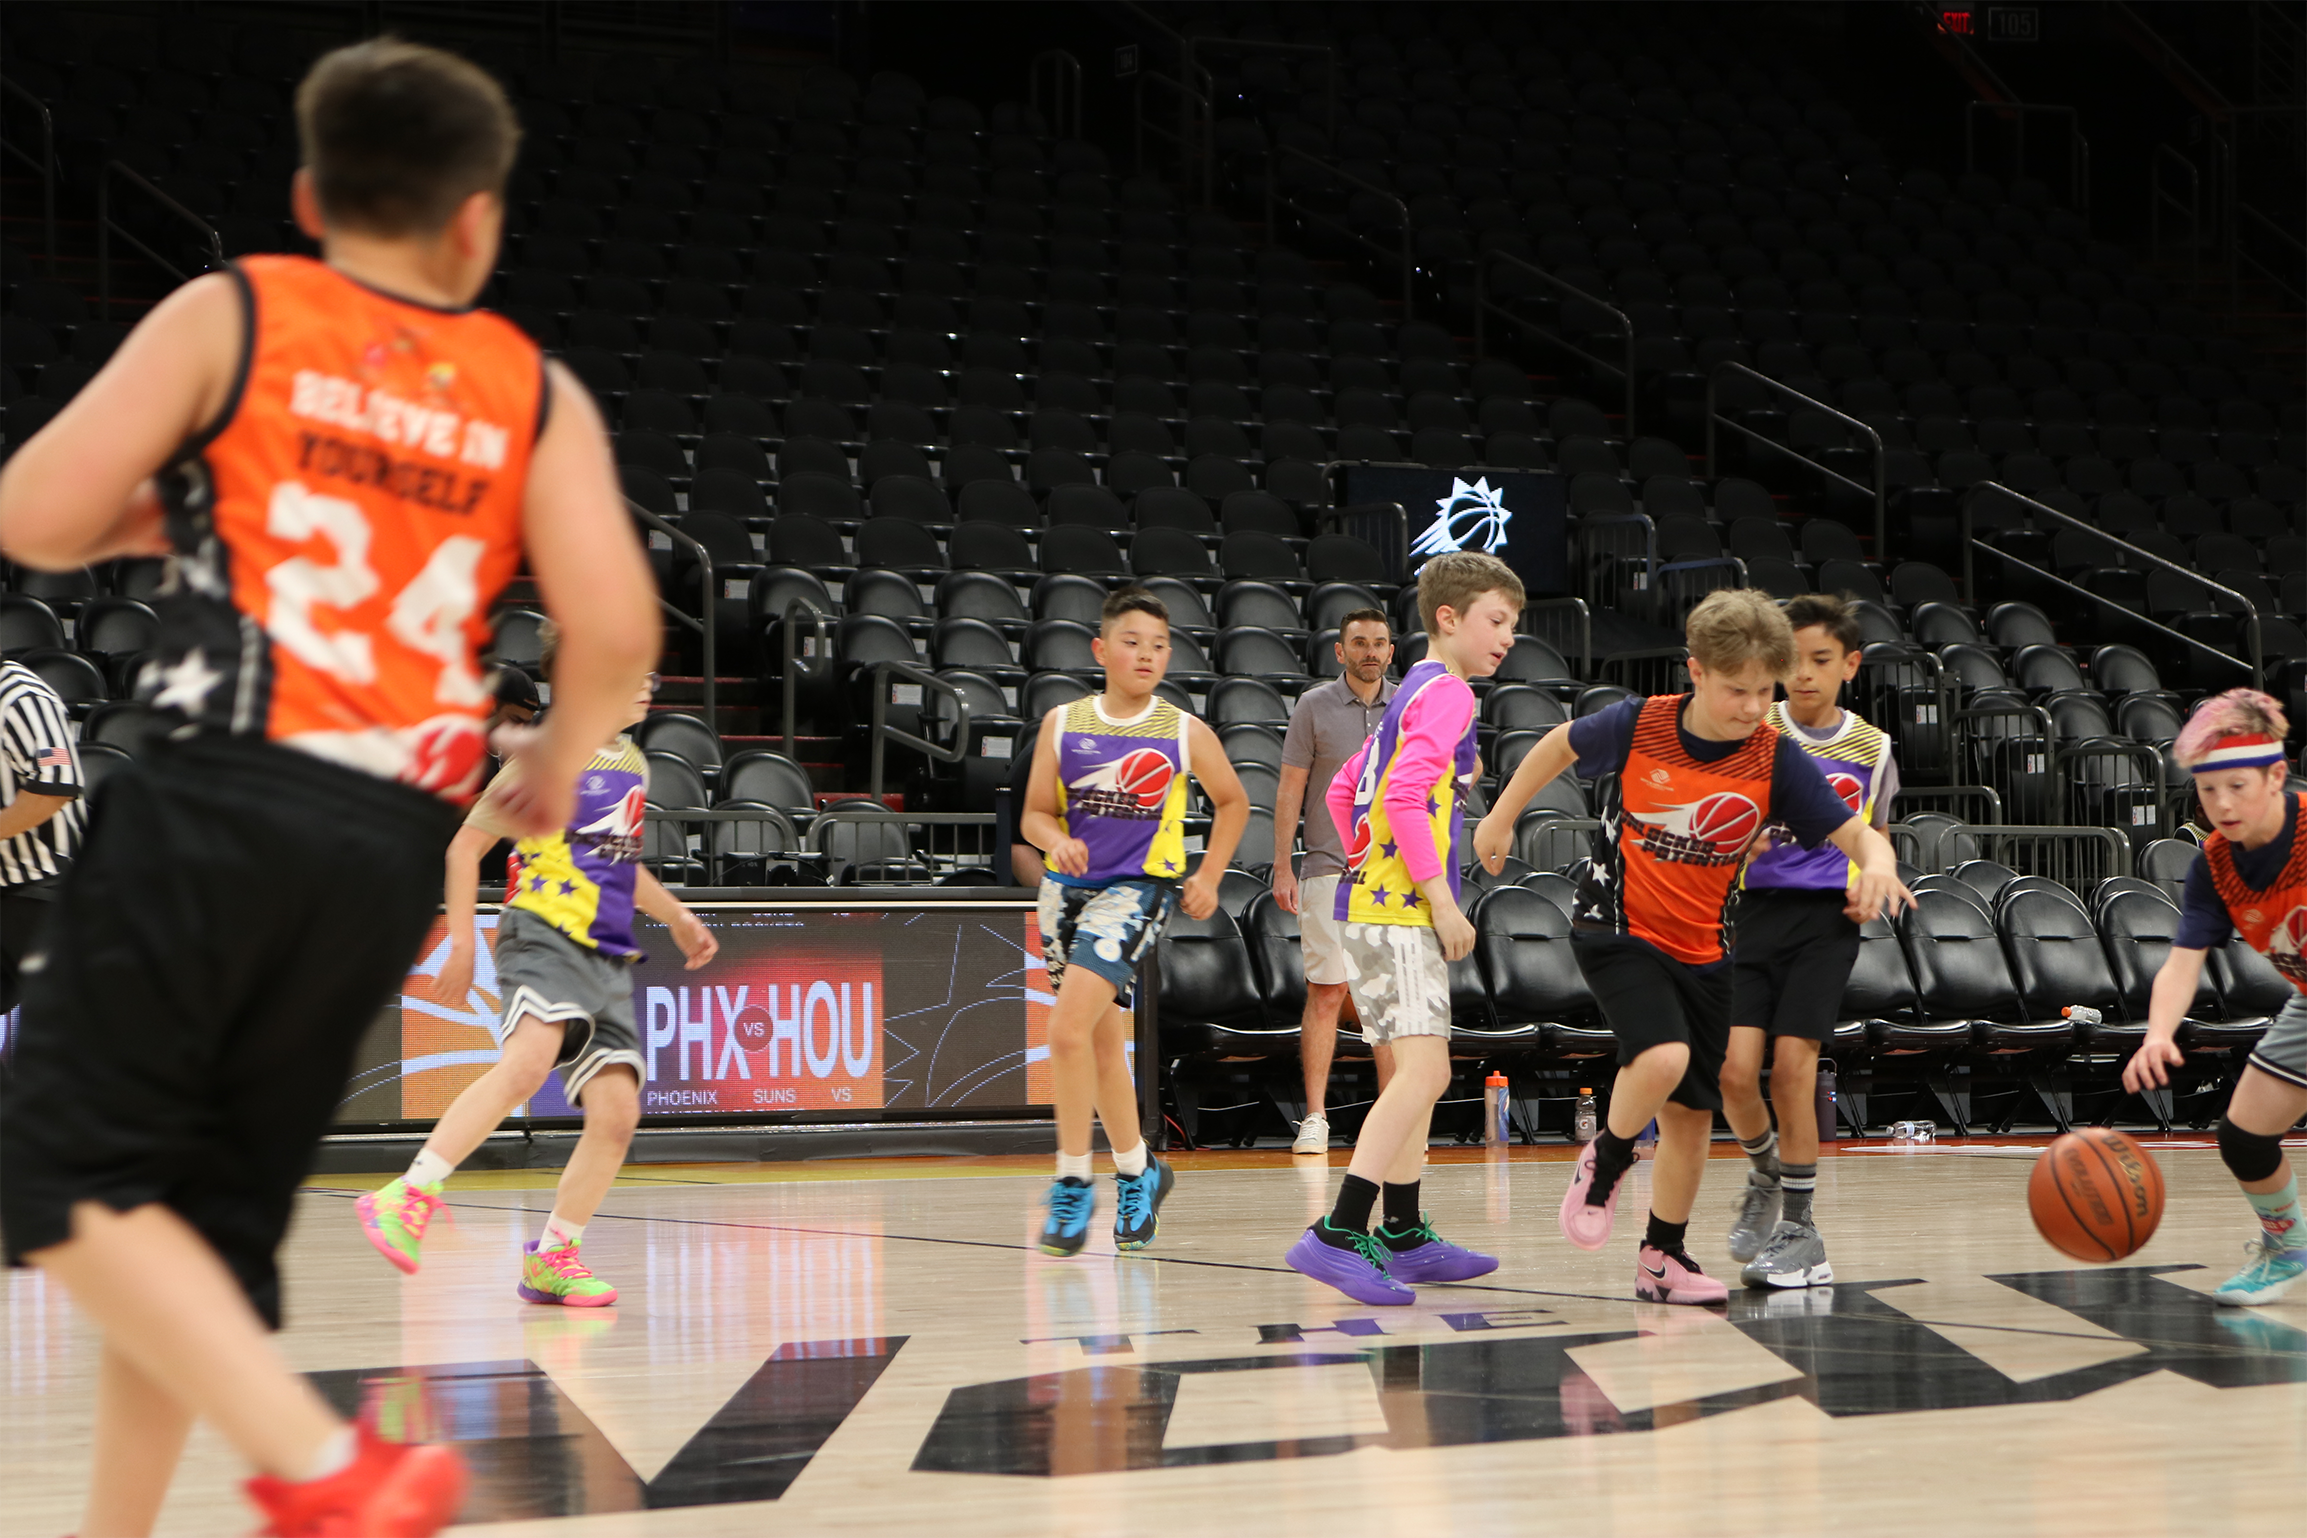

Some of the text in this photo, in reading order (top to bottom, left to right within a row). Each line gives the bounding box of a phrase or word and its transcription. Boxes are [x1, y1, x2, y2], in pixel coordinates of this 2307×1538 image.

[1943, 12, 1970, 33] EXIT
[1998, 13, 2031, 36] 105
[290, 368, 509, 470] BELIEVE IN
[297, 430, 490, 516] YOURSELF
[263, 480, 488, 708] 24
[646, 980, 874, 1081] PHX VS HOU
[647, 1087, 853, 1106] PHOENIX SUNS VS
[1579, 1119, 1589, 1130] G
[2101, 1135, 2149, 1218] Wilson
[1019, 1308, 1571, 1355] THE
